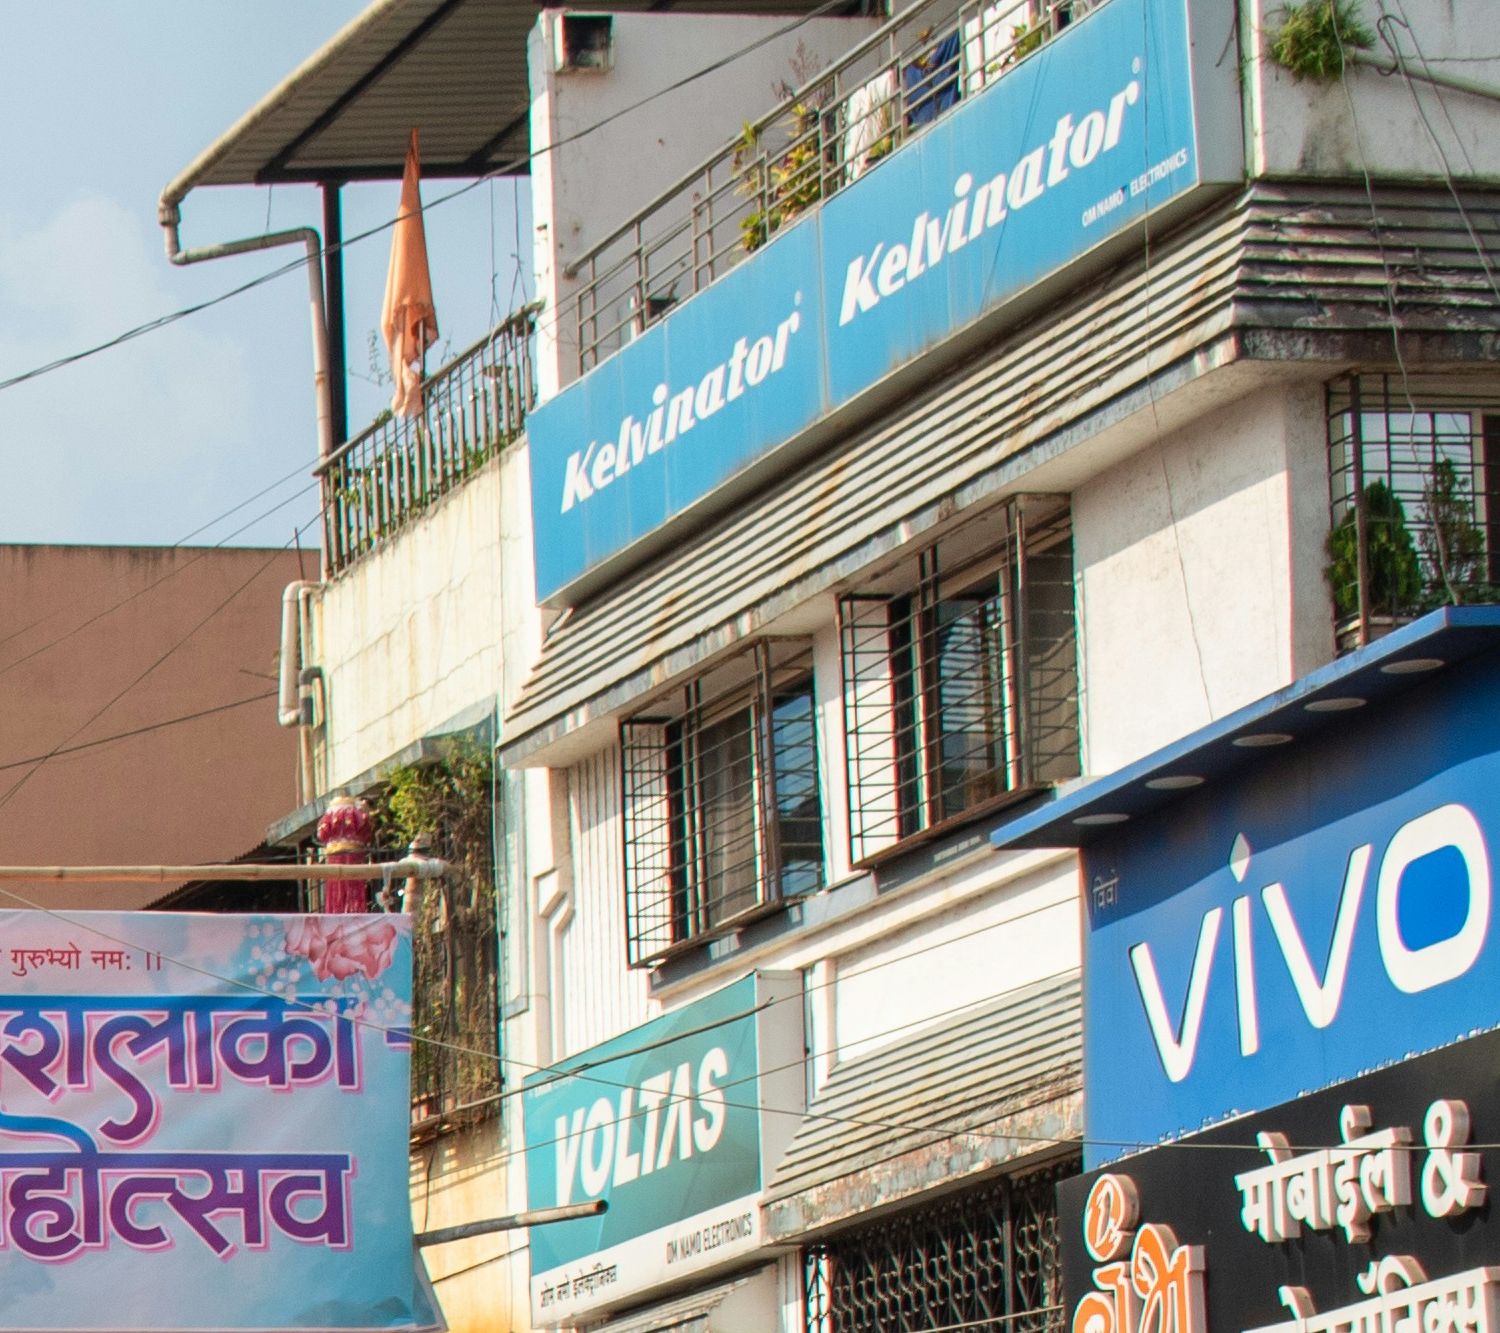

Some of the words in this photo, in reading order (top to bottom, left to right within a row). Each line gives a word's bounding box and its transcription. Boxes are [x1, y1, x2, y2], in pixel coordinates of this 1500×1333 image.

[837, 78, 1141, 328] Kelvinator
[1130, 148, 1187, 197] ELECTRONICS
[560, 309, 801, 514] Kelvinator
[1129, 803, 1490, 1082] vivo
[554, 1047, 729, 1206] VOLTAS
[1234, 1105, 1412, 1244] मोबाईल
[1422, 1100, 1488, 1218] &
[666, 1242, 677, 1264] OM
[680, 1232, 701, 1259] NAMO
[703, 1213, 752, 1251] ELECTRONICS
